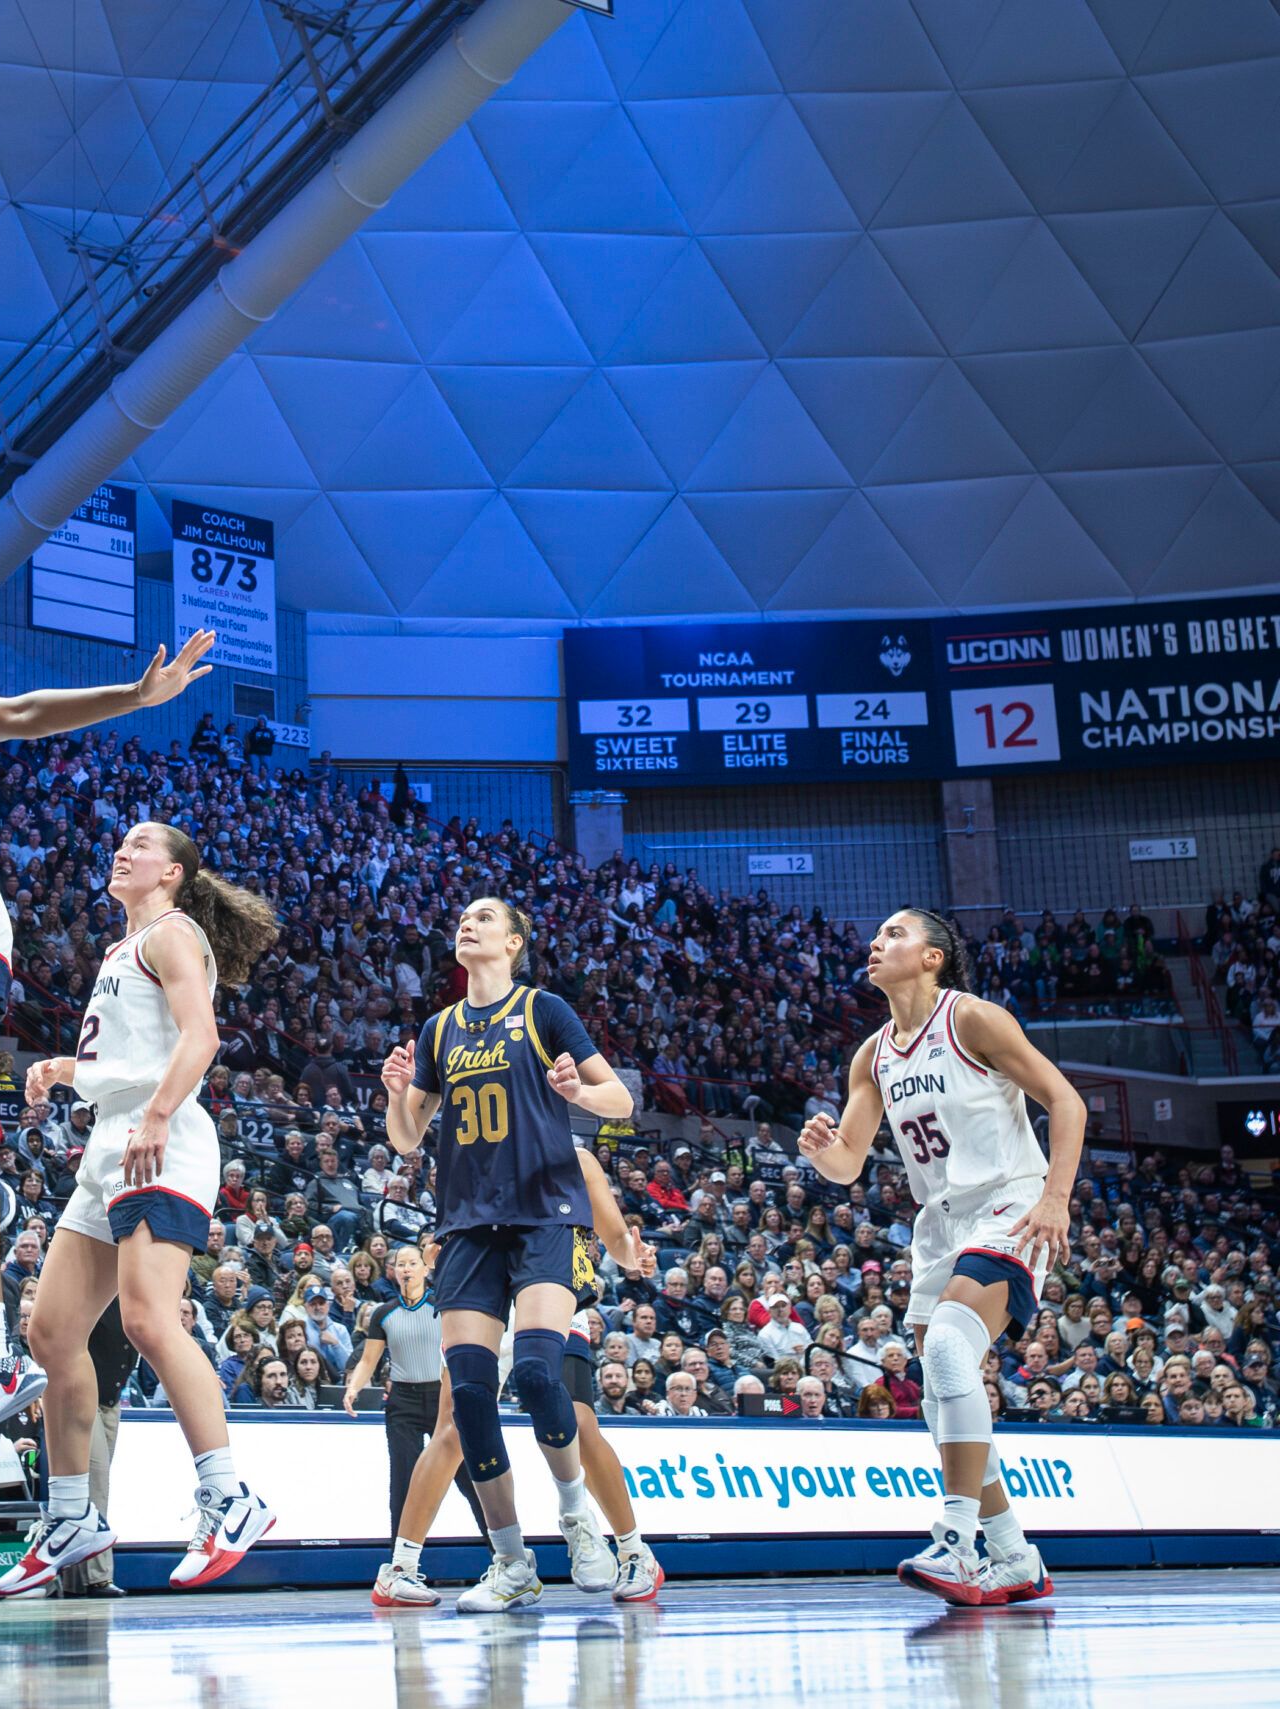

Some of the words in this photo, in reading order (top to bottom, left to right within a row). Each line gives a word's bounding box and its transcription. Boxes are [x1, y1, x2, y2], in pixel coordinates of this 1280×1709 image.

[93, 510, 127, 527] YEAR
[202, 512, 245, 532] COACH
[182, 525, 202, 540] JIM
[205, 530, 266, 552] CALHOUN
[191, 548, 257, 592] 873
[198, 585, 230, 599] CAREER
[231, 592, 252, 603] WINS
[182, 594, 189, 605] 3
[188, 596, 217, 611] National
[218, 602, 269, 622] Championships
[204, 614, 210, 625] 4
[210, 616, 228, 629] Final
[229, 619, 248, 632] Fours
[179, 625, 187, 636] 17
[222, 634, 272, 654] Championships
[946, 636, 1051, 665] UCONN
[1061, 622, 1179, 662] WOMEN'S
[223, 650, 242, 663] Fame
[243, 654, 272, 669] Inductee
[699, 651, 754, 666] NCAA
[661, 671, 795, 688] TOURNAMENT
[617, 705, 652, 727] 32
[735, 702, 771, 724] 29
[854, 699, 891, 720] 24
[974, 702, 1038, 749] 12
[281, 727, 309, 744] 223
[723, 734, 787, 752] ELITE
[840, 731, 908, 748] FINAL
[595, 736, 677, 755] SWEET
[596, 756, 678, 771] SIXTEENS
[724, 753, 788, 768] EIGHTS
[842, 749, 910, 764] FOURS
[1132, 845, 1153, 856] SEC
[1169, 841, 1190, 855] 13
[751, 860, 772, 870] SEC
[787, 857, 806, 871] 12
[446, 1039, 510, 1081] Irish
[885, 1074, 945, 1110] UCONN
[451, 1082, 508, 1146] 30
[900, 1112, 951, 1164] 35
[760, 1167, 781, 1179] SEC
[715, 1452, 762, 1498] in
[765, 1465, 856, 1508] your
[1002, 1457, 1076, 1499] bill?
